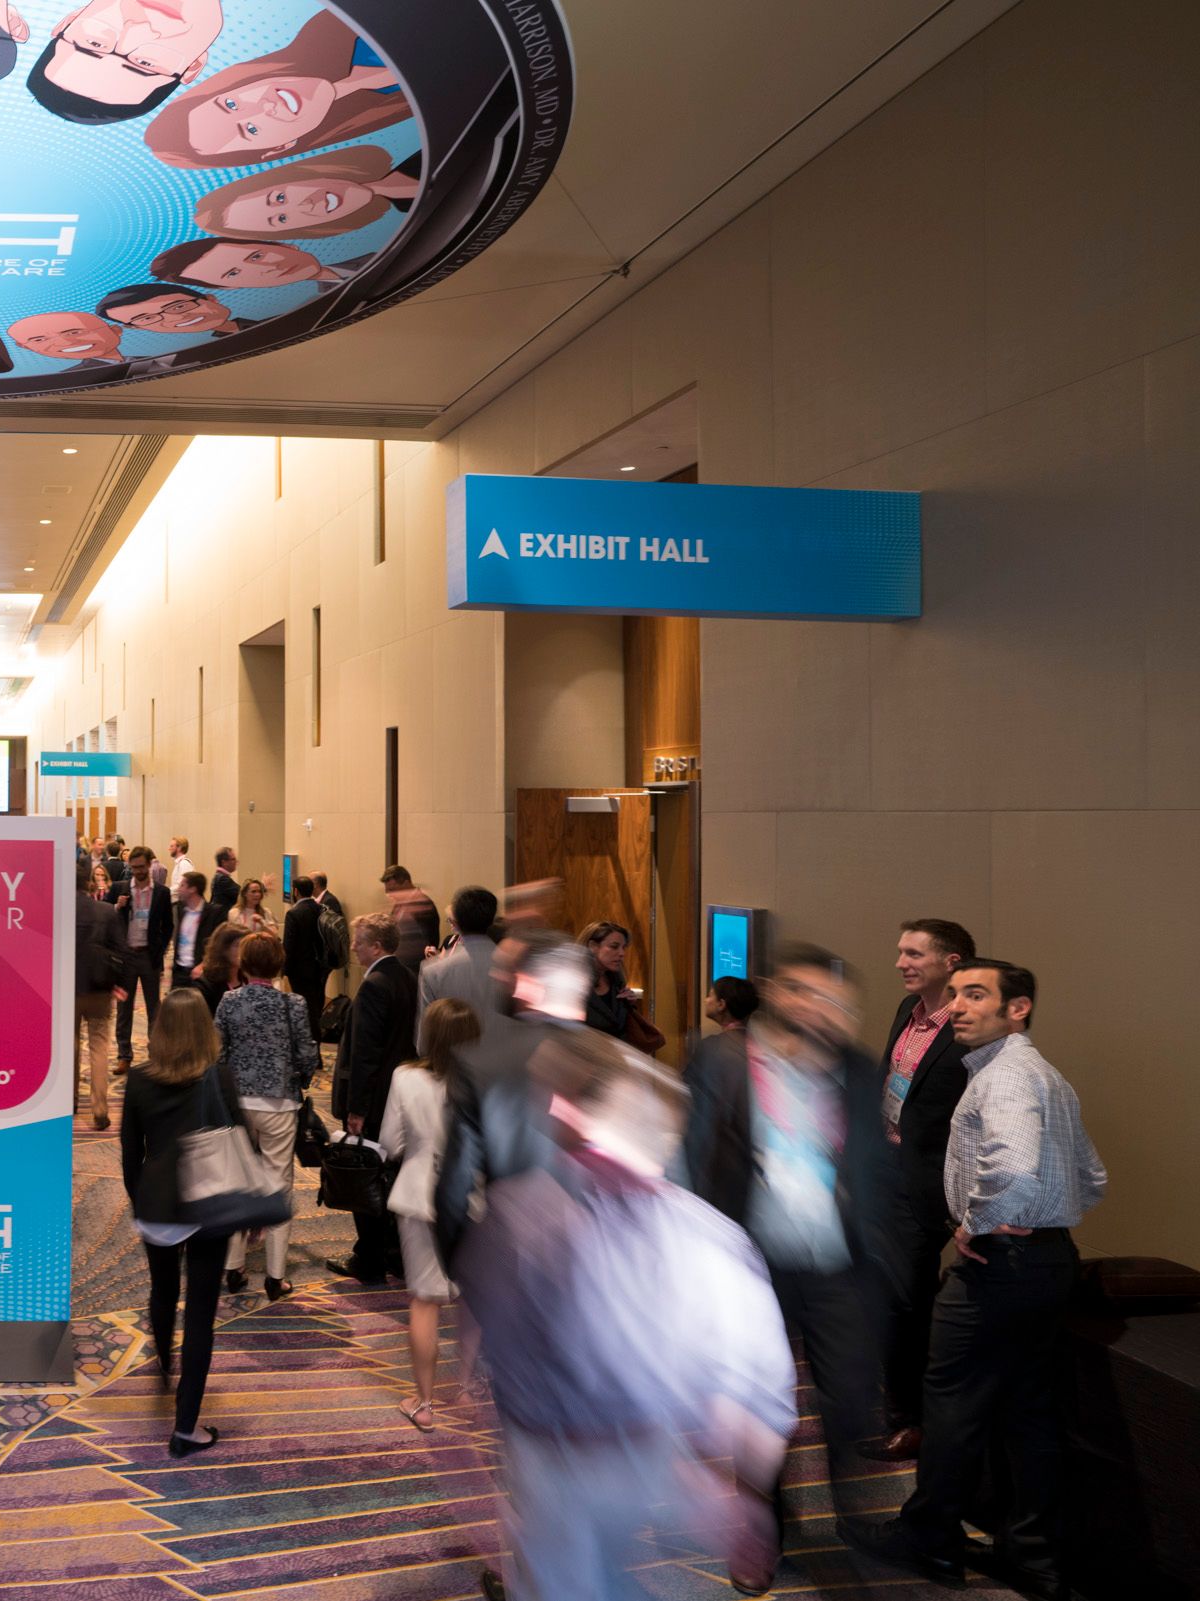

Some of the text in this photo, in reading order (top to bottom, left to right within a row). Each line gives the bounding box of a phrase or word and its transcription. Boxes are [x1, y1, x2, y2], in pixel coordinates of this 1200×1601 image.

[535, 87, 559, 116] MD
[468, 127, 558, 257] DR. AMY ABERNETHY
[29, 258, 68, 267] OF
[519, 532, 710, 563] EXHIBIT HALL
